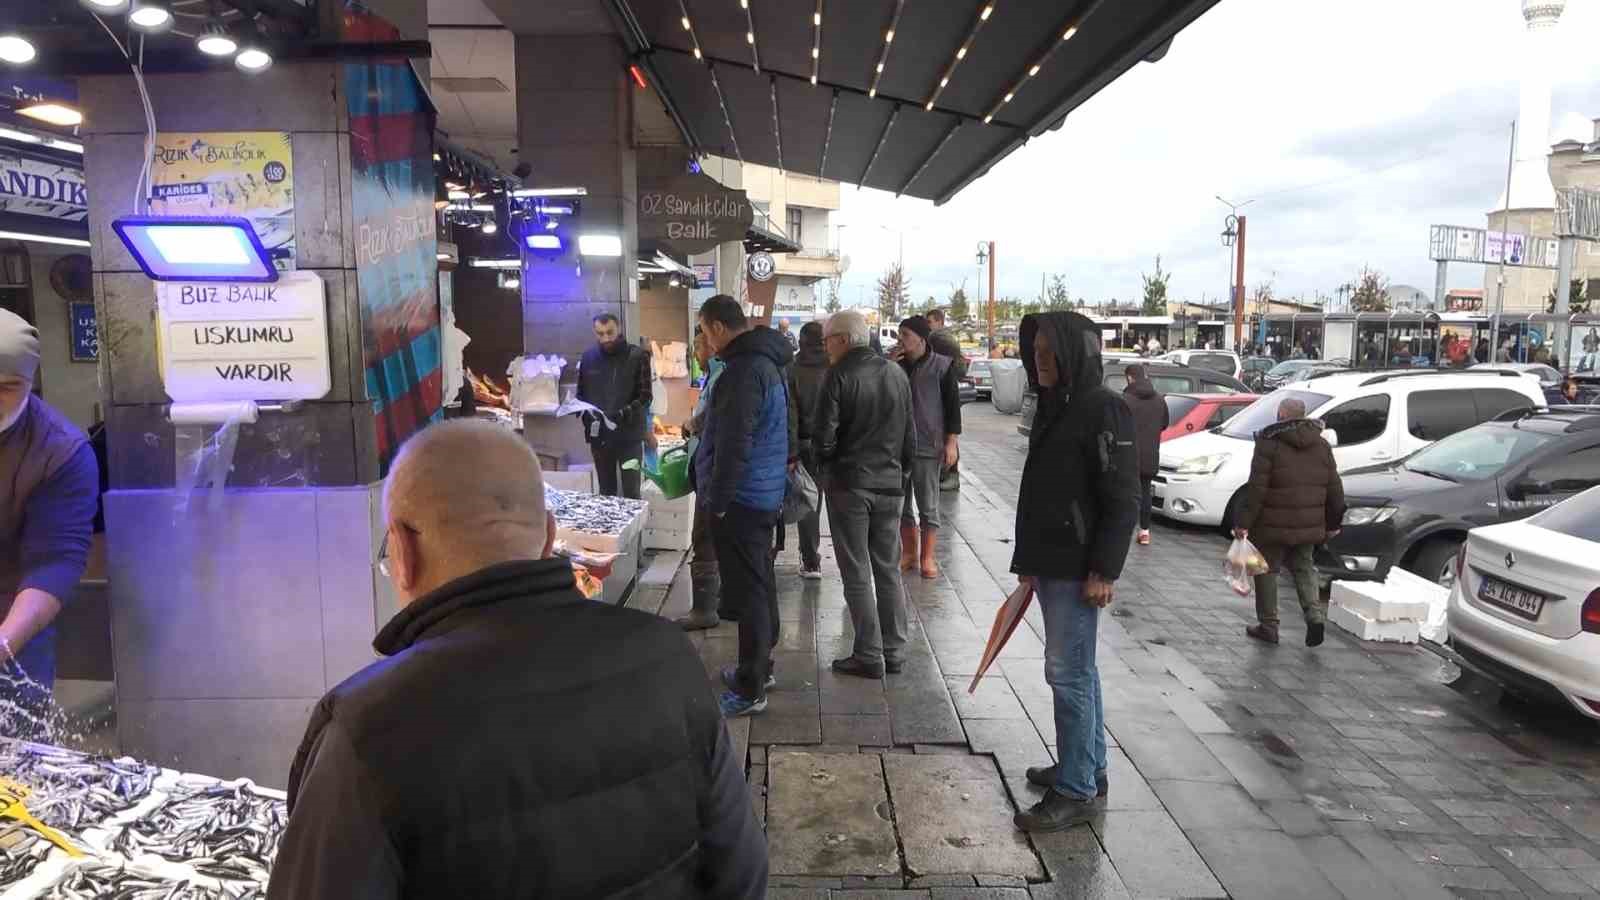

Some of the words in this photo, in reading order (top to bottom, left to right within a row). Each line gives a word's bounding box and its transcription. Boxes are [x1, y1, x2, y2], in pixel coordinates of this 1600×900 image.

[181, 285, 221, 305] BUZ
[226, 285, 279, 303] BALIK
[194, 325, 294, 345] USKUMRU
[216, 362, 293, 382] VARDIR
